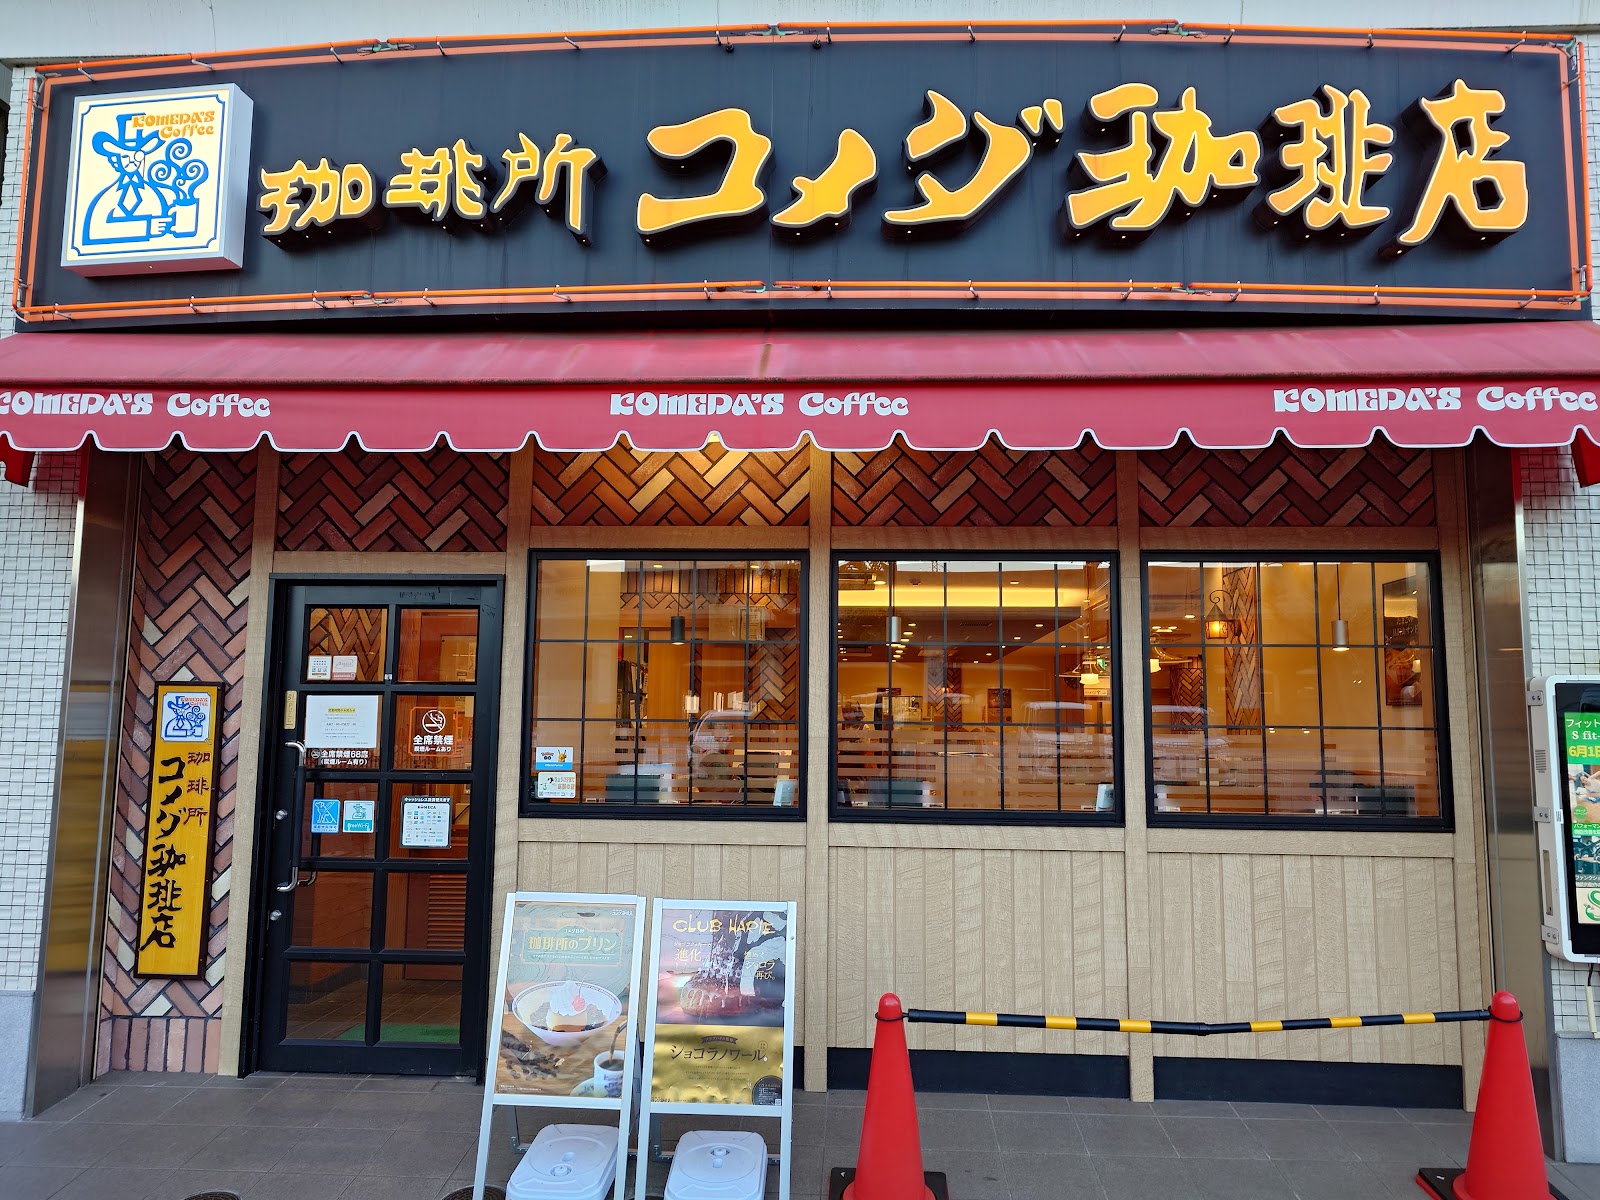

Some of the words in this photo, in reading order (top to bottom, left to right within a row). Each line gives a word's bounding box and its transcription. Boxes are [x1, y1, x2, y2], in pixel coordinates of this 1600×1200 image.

[132, 110, 215, 128] KOMEDA'S
[160, 125, 215, 139] Coffee
[259, 131, 597, 232] 珈琲所
[166, 392, 271, 417] Coffee
[610, 392, 784, 416] KOMEDA'S
[798, 392, 909, 416] Coffee
[1273, 386, 1462, 413] KOMEDA'S
[1477, 386, 1598, 413] Coffee
[412, 734, 454, 746] 全席禁煙
[184, 752, 210, 826] 珈琲所
[672, 913, 723, 933] CLUB
[527, 935, 617, 952] 珈琲所のプリン
[670, 1044, 766, 1062] ショコラノワール
